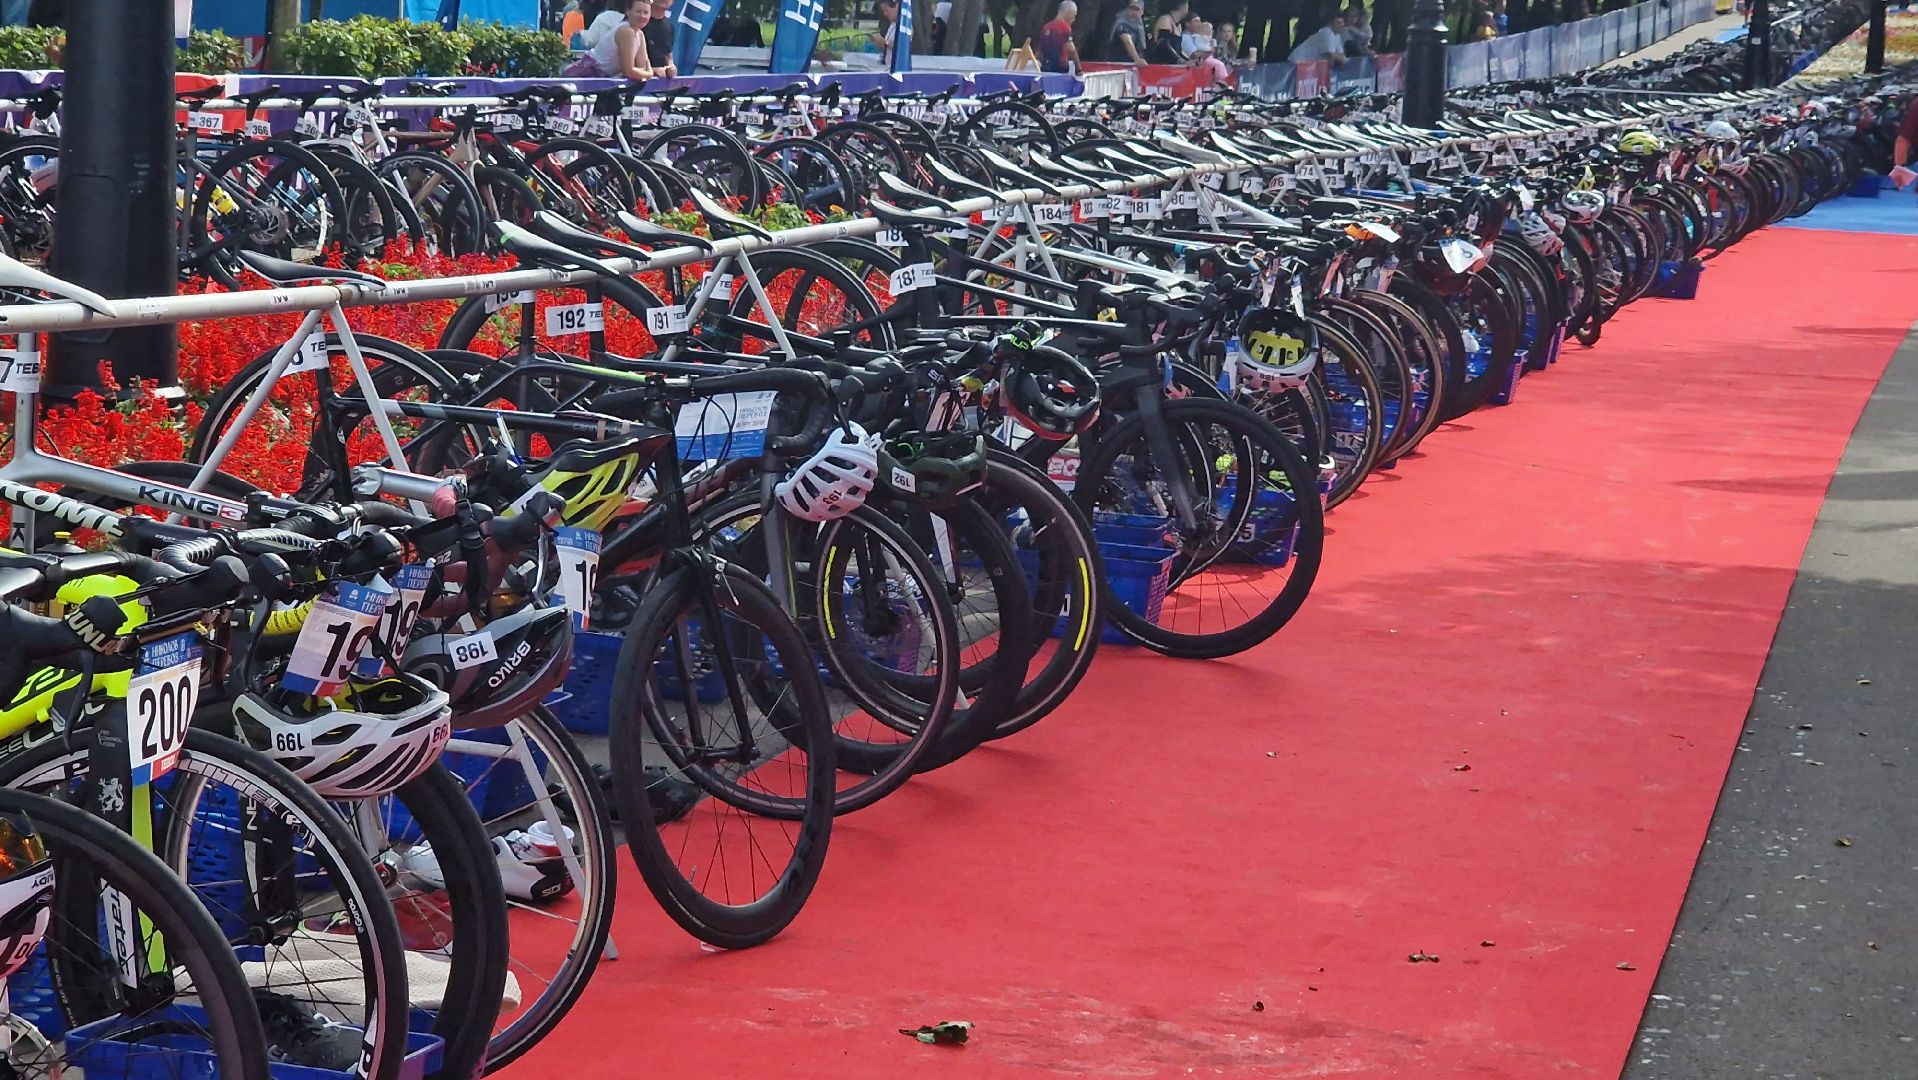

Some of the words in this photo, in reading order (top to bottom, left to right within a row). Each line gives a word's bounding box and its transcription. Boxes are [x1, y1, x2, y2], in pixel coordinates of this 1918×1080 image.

[199, 117, 219, 127] 367
[252, 124, 269, 135] 366
[1039, 208, 1062, 220] 184
[1132, 202, 1150, 213] 181
[885, 229, 904, 242] 18
[556, 308, 586, 330] 192
[653, 313, 669, 329] 191
[894, 472, 910, 488] 192
[823, 490, 842, 505] 193
[384, 599, 420, 656] 19
[320, 621, 375, 681] 19
[456, 640, 488, 663] 198
[487, 640, 532, 688] BRIKO
[138, 675, 192, 761] 200
[276, 732, 306, 752] 199
